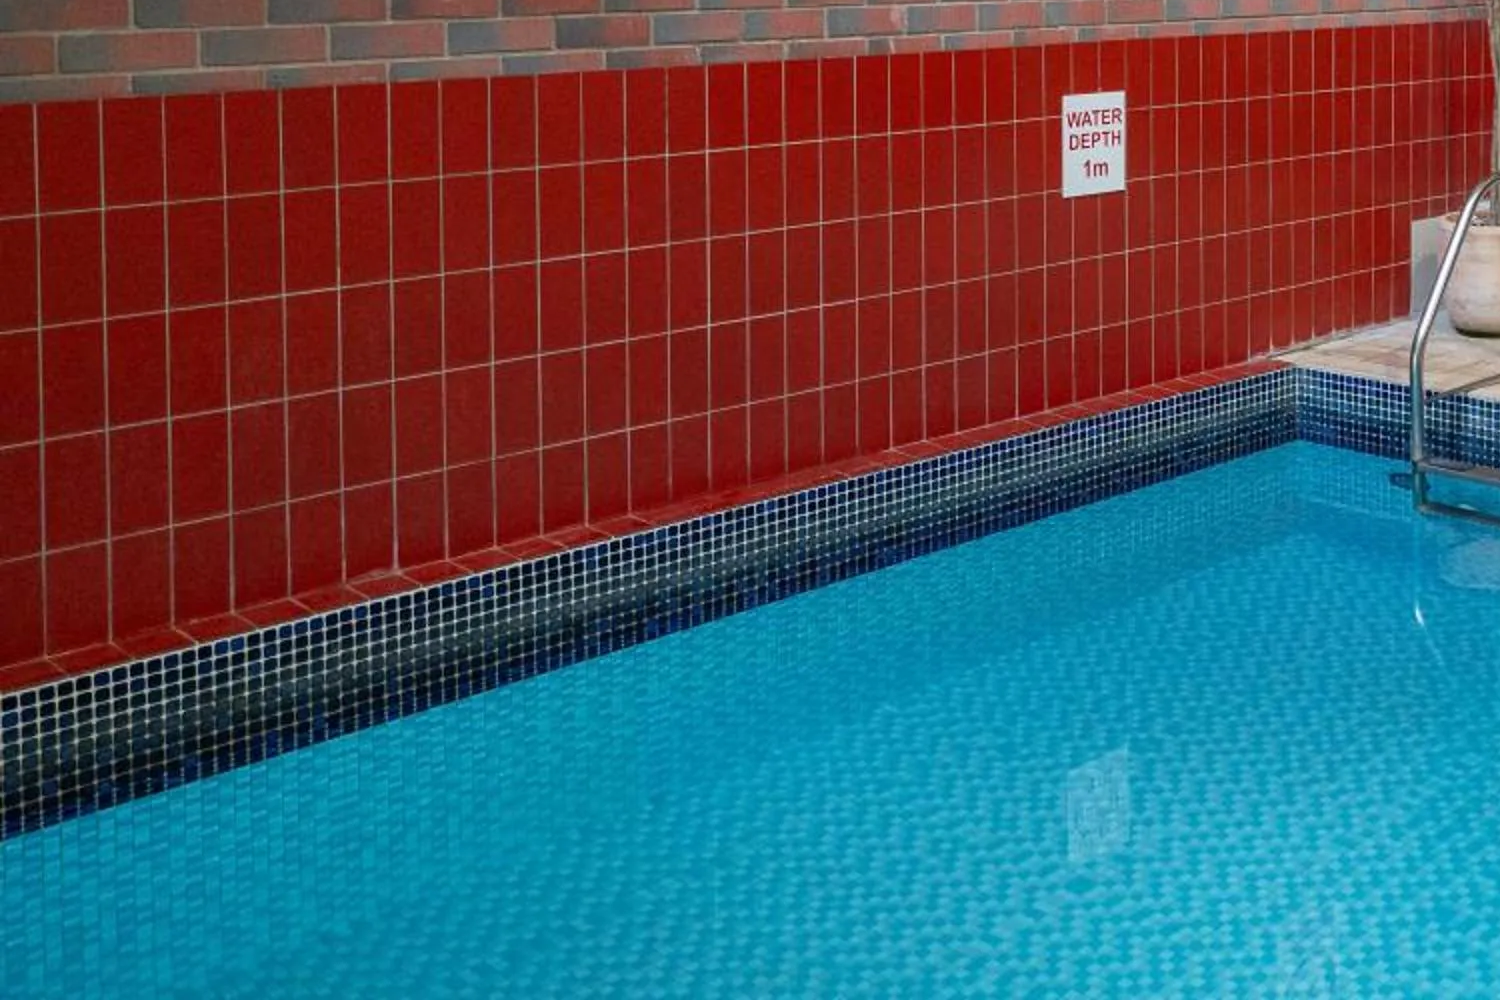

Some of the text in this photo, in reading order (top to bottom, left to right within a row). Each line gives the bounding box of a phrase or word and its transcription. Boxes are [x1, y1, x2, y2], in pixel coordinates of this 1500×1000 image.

[1067, 107, 1122, 129] WATER
[1069, 130, 1121, 151] DEPTH
[1083, 159, 1109, 178] 1m
